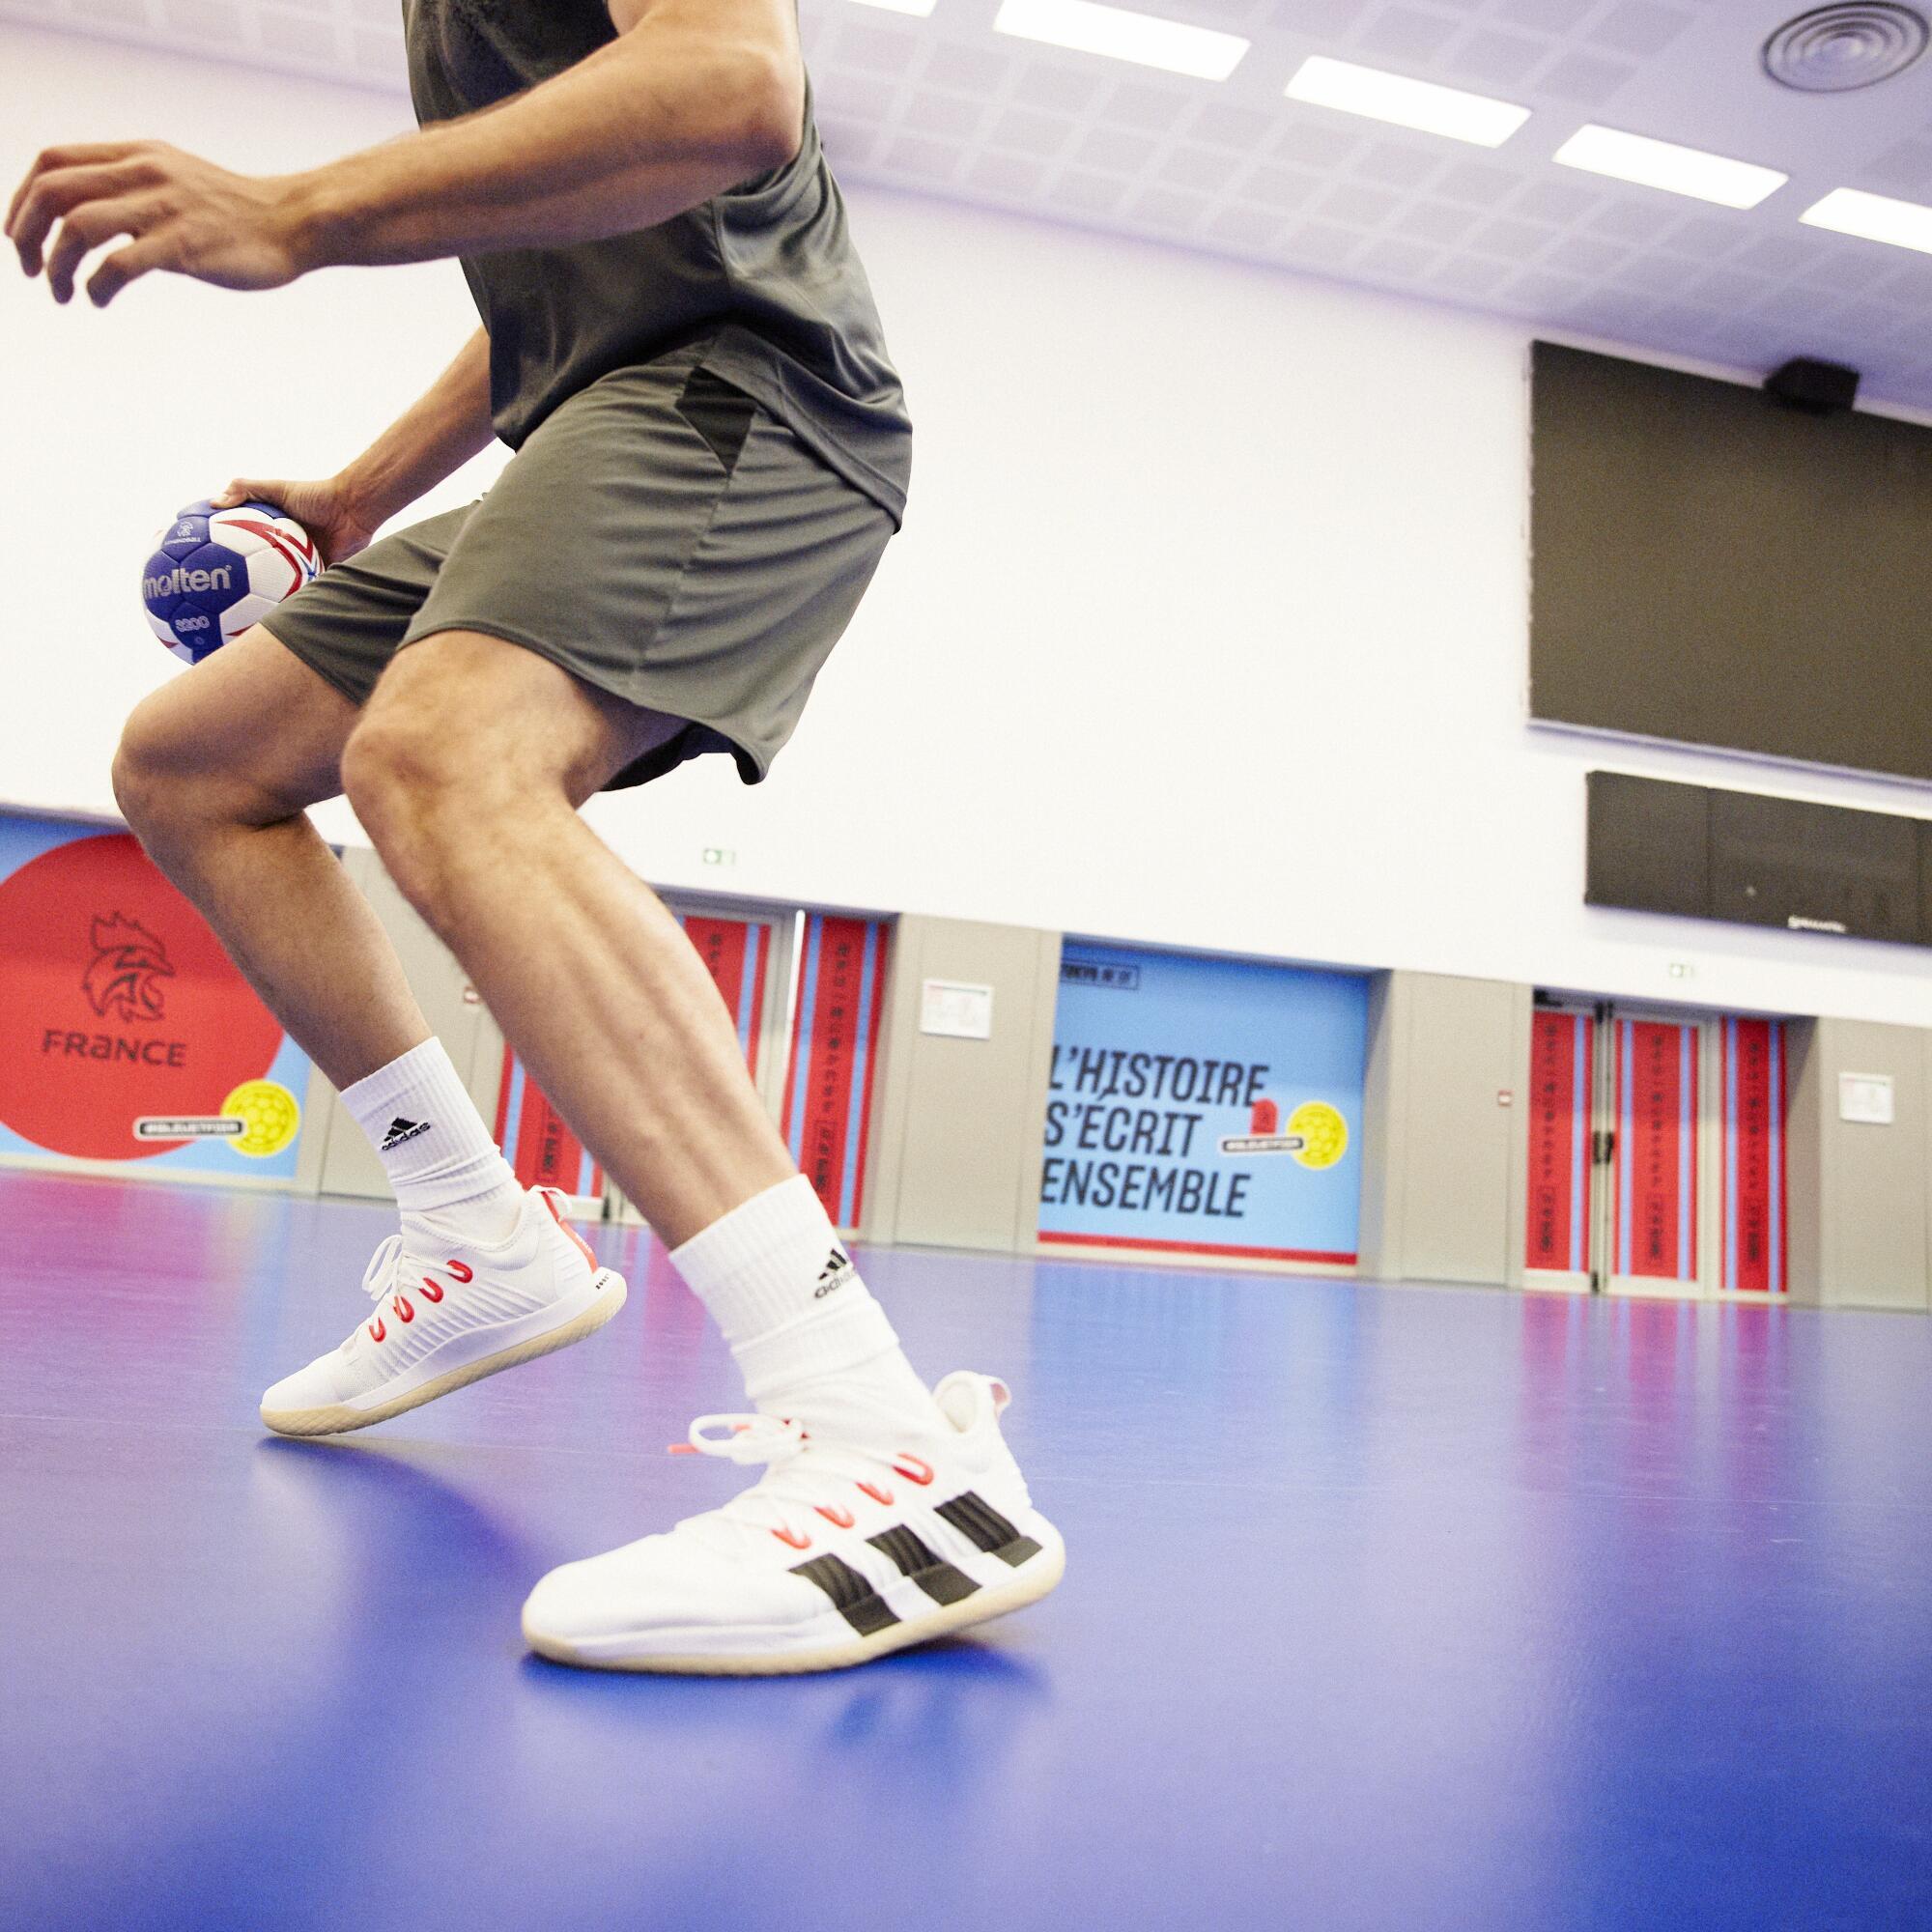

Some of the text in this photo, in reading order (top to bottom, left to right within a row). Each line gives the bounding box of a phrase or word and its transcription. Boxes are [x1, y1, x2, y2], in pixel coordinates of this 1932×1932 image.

[145, 567, 231, 599] molten
[382, 1122, 431, 1151] adidas
[1040, 1157, 1251, 1219] ENSEMBLE
